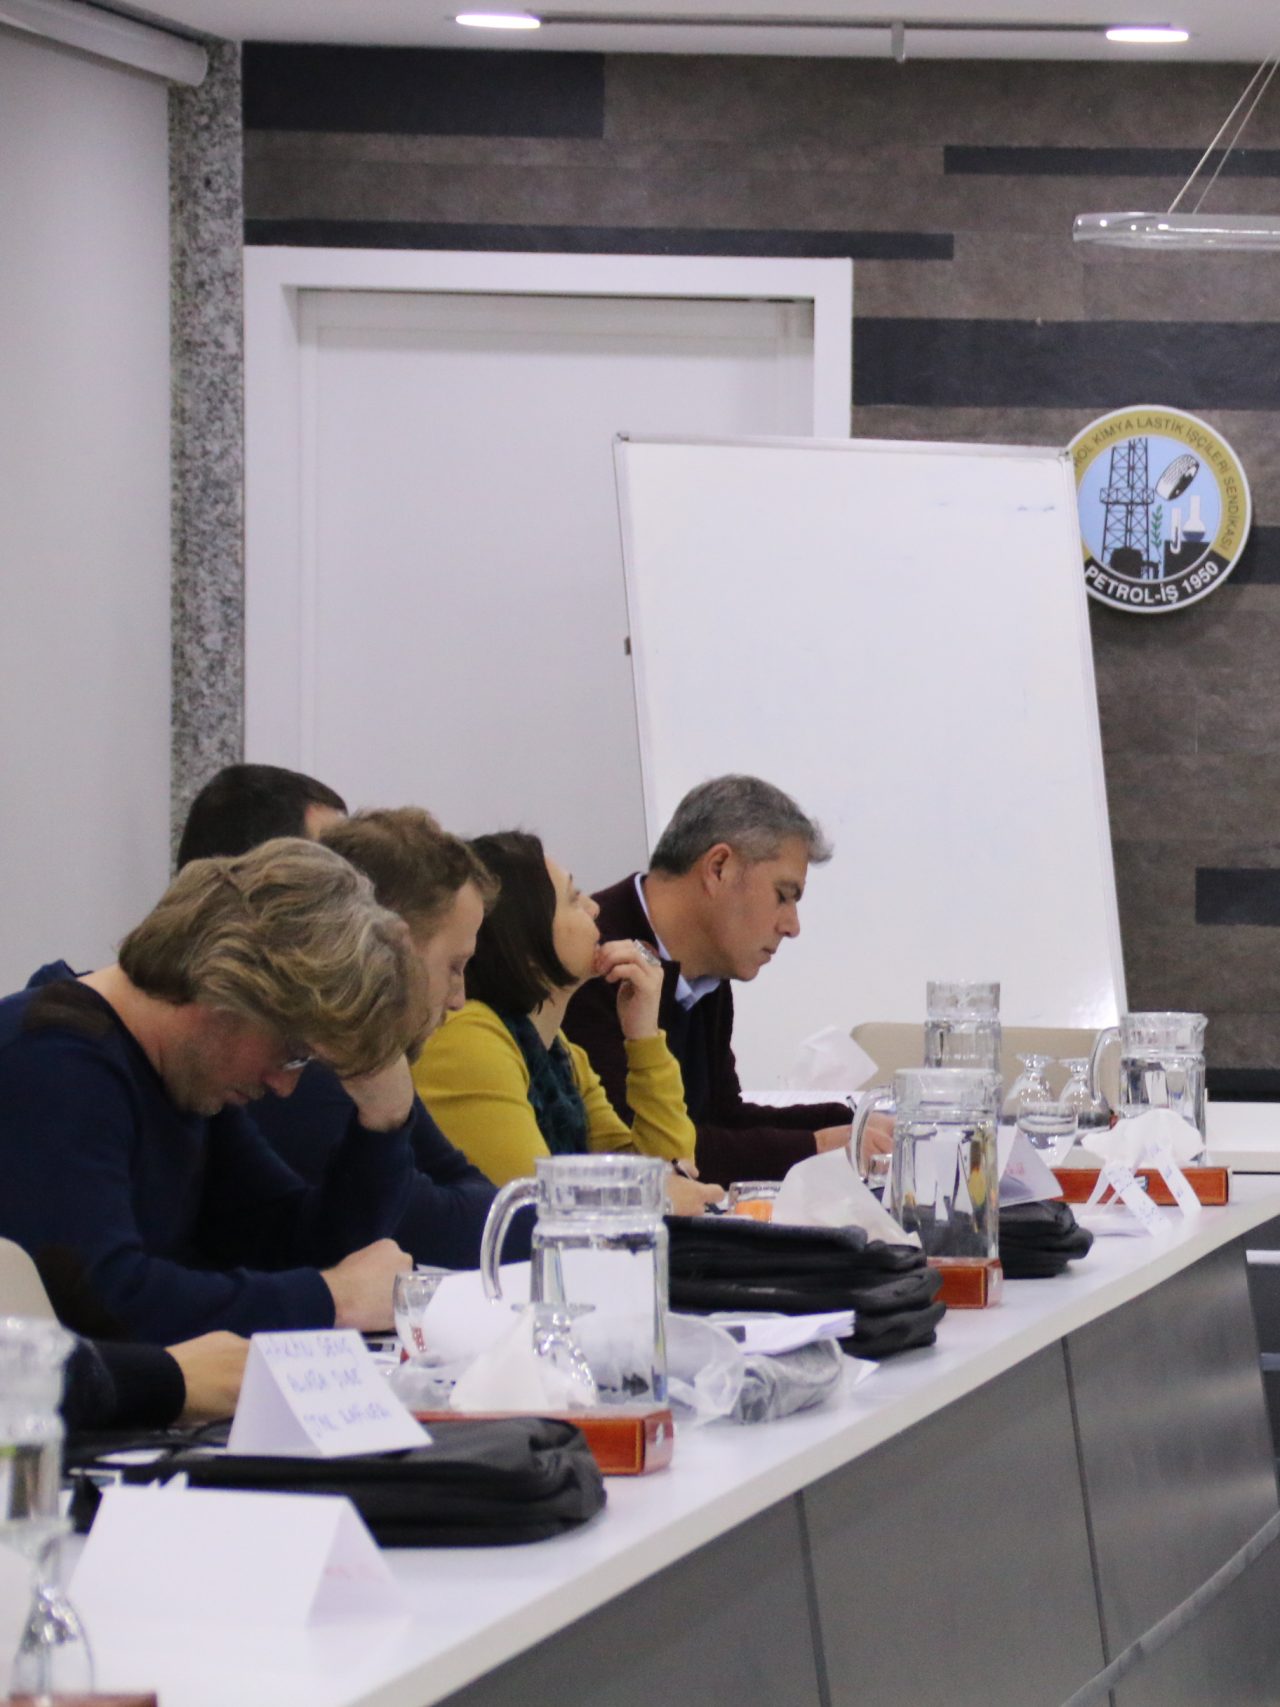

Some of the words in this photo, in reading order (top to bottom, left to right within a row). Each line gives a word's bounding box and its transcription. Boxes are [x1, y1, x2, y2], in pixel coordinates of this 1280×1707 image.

[1091, 418, 1134, 446] KİMYA
[1136, 415, 1184, 434] LASTİK
[1220, 475, 1240, 551] SENDİKASI
[1085, 565, 1179, 604] PETROL-İŞ
[1181, 560, 1220, 595] 1950
